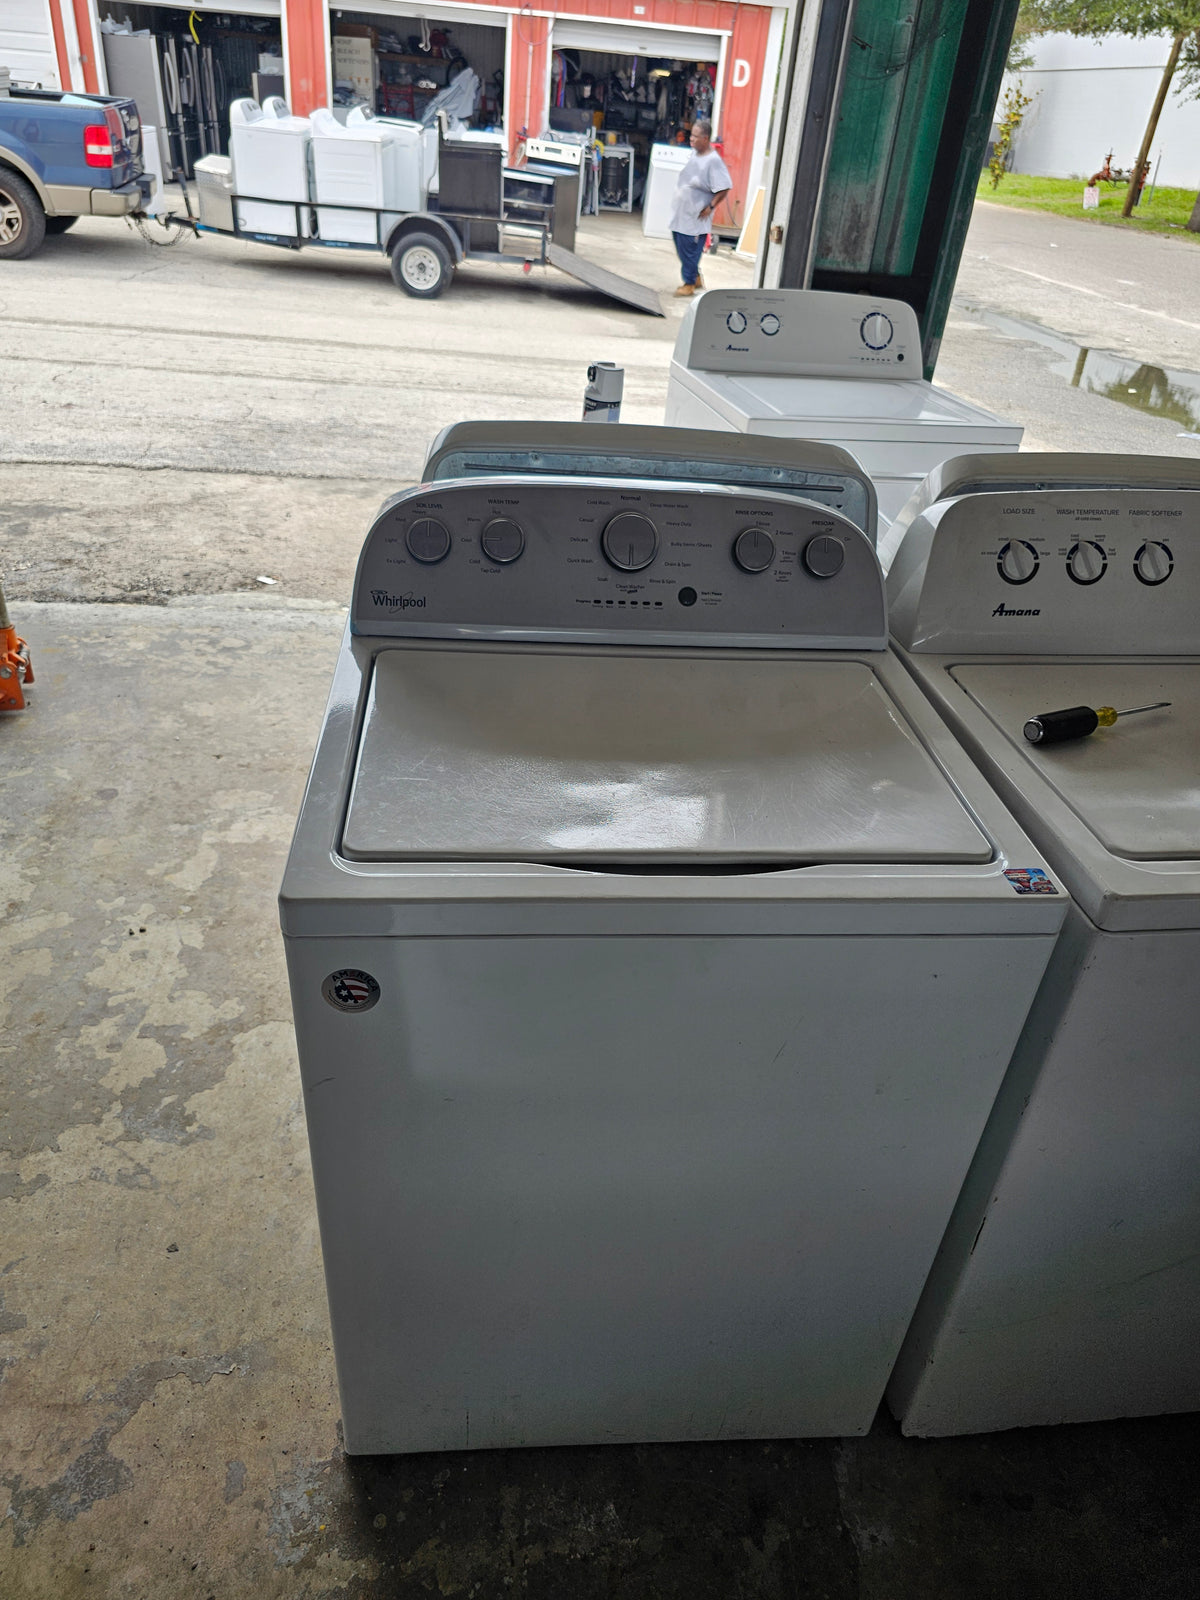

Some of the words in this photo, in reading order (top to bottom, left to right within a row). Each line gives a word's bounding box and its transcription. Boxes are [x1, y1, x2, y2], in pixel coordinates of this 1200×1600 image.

[732, 59, 751, 87] D
[372, 594, 427, 611] Whirlpool
[991, 602, 1041, 617] Amana
[331, 970, 378, 992] AMERICA
